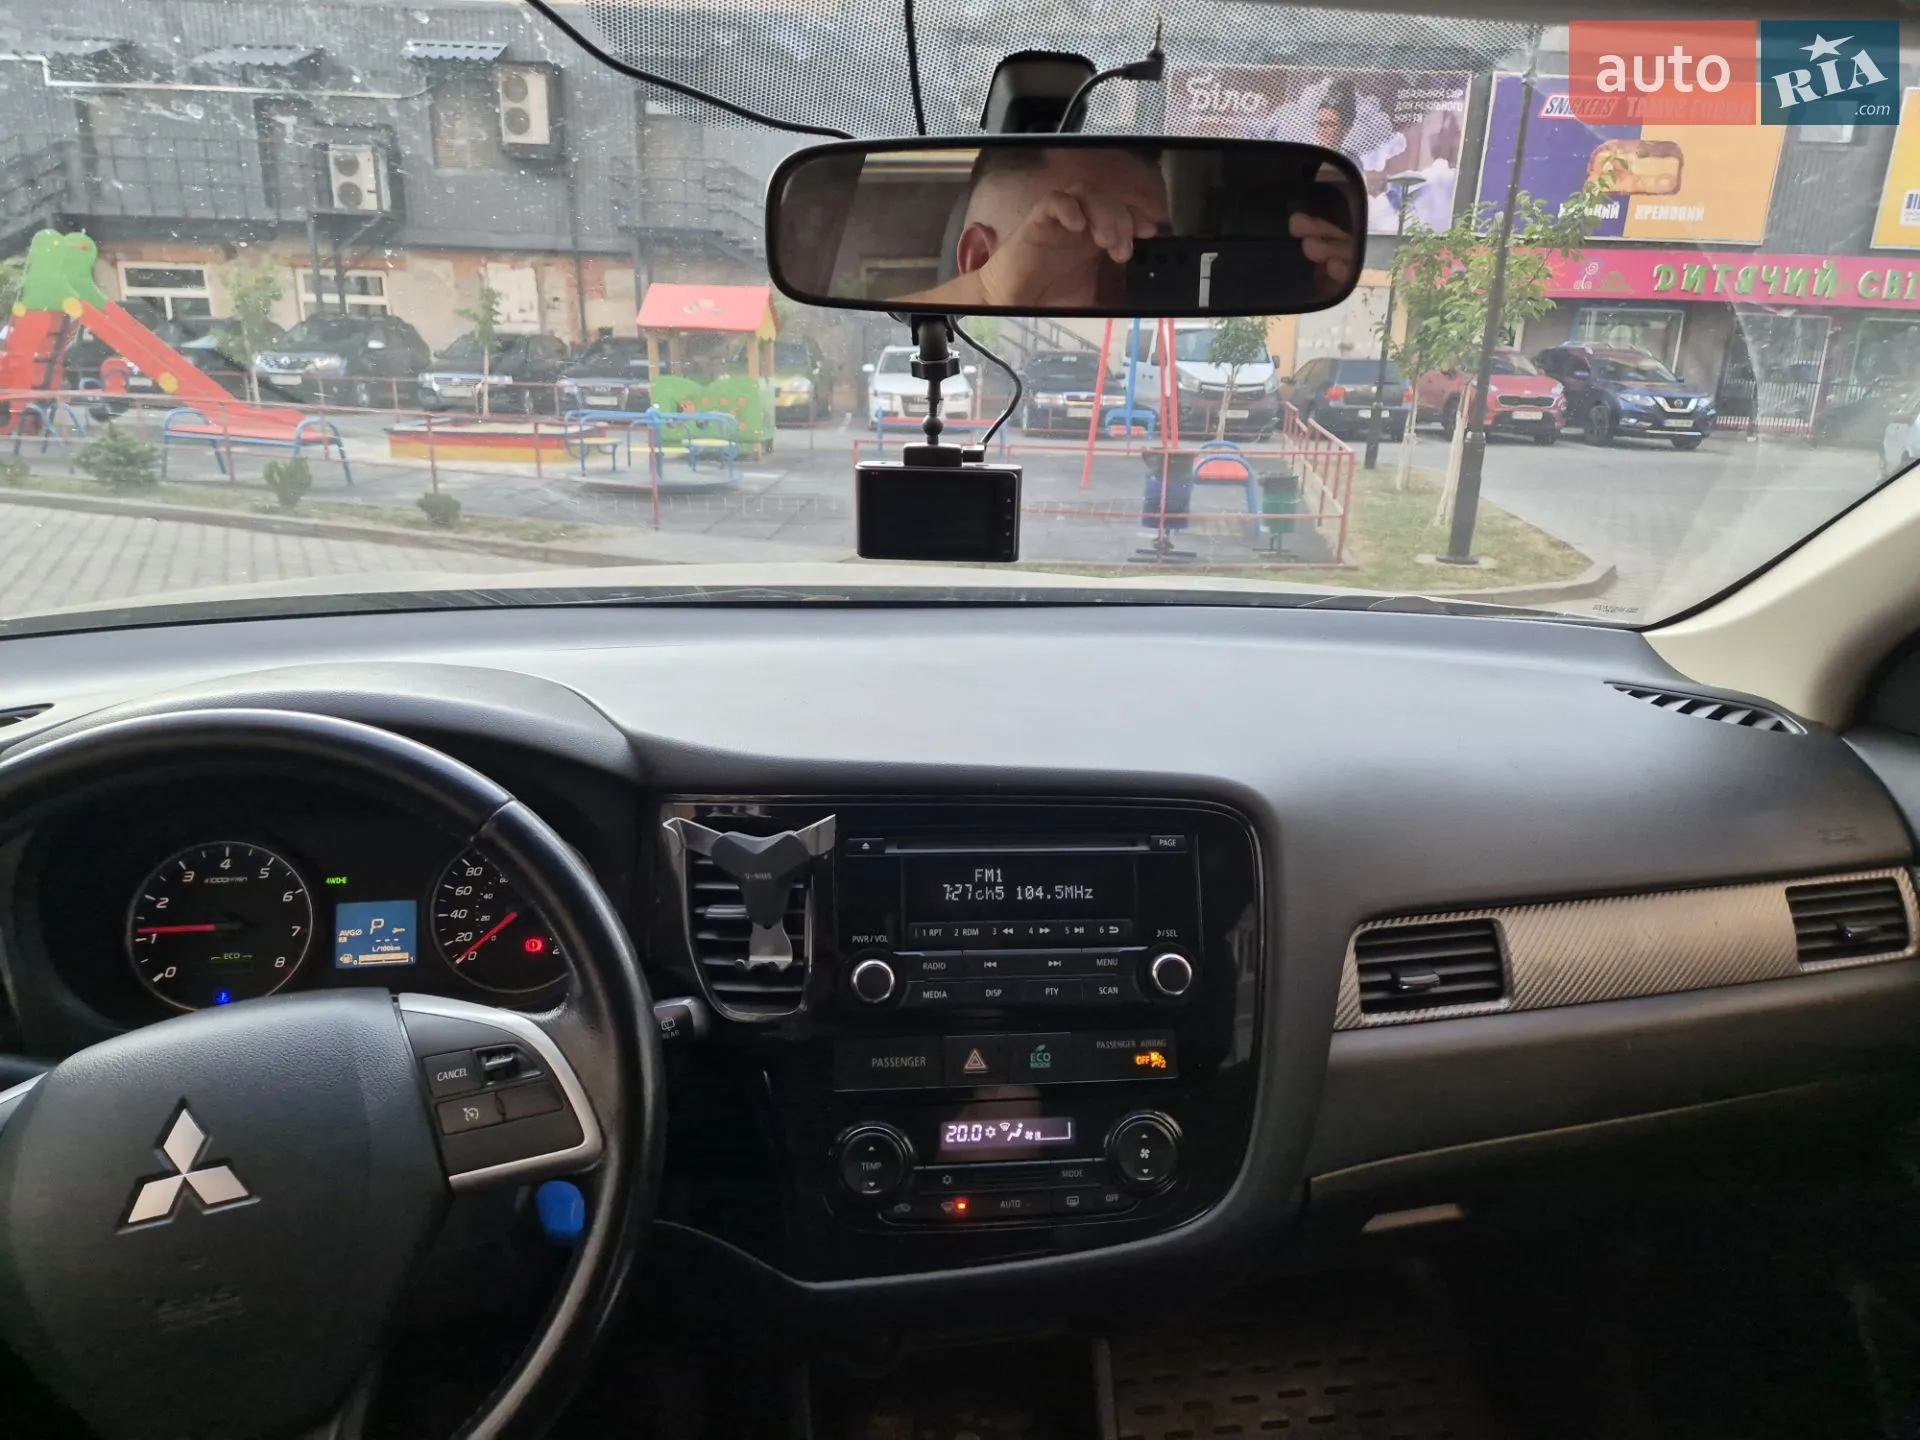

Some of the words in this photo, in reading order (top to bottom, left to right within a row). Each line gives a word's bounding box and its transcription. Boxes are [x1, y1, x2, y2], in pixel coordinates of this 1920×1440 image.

[1545, 96, 1616, 117] SNICKERS
[1653, 259, 1839, 299] ДИТЯЧИЙ
[1159, 838, 1177, 847] PAGE
[220, 858, 231, 870] 4
[183, 870, 195, 882] 3
[258, 867, 270, 879] 5
[465, 866, 483, 877] 80
[974, 868, 1003, 883] FM1
[282, 890, 294, 902] 6
[455, 885, 473, 896] 60
[1016, 884, 1094, 900] 104.5MHz
[156, 897, 170, 909] 2
[450, 908, 468, 919] 40
[291, 925, 301, 937] 7
[369, 918, 385, 935] P
[962, 928, 979, 936] RDM
[150, 933, 157, 944] 1
[454, 931, 473, 942] 20
[929, 929, 942, 937] RPT
[223, 952, 241, 960] ECO
[467, 951, 478, 961] 0
[274, 956, 286, 968] 8
[922, 962, 947, 970] RADIO
[1096, 958, 1119, 967] MENU
[164, 966, 177, 979] 0
[922, 990, 948, 999] MEDIA
[985, 989, 1002, 998] DISP
[1045, 987, 1059, 996] PTY
[1099, 986, 1119, 995] SCAN
[871, 1056, 927, 1069] PASSENGER
[1030, 1052, 1051, 1062] ECO
[436, 1067, 469, 1082] CANCEL
[945, 1124, 983, 1143] 20.0
[861, 1161, 882, 1171] TEMP
[1105, 1193, 1120, 1202] OFF
[1000, 1199, 1021, 1209] AUTO
